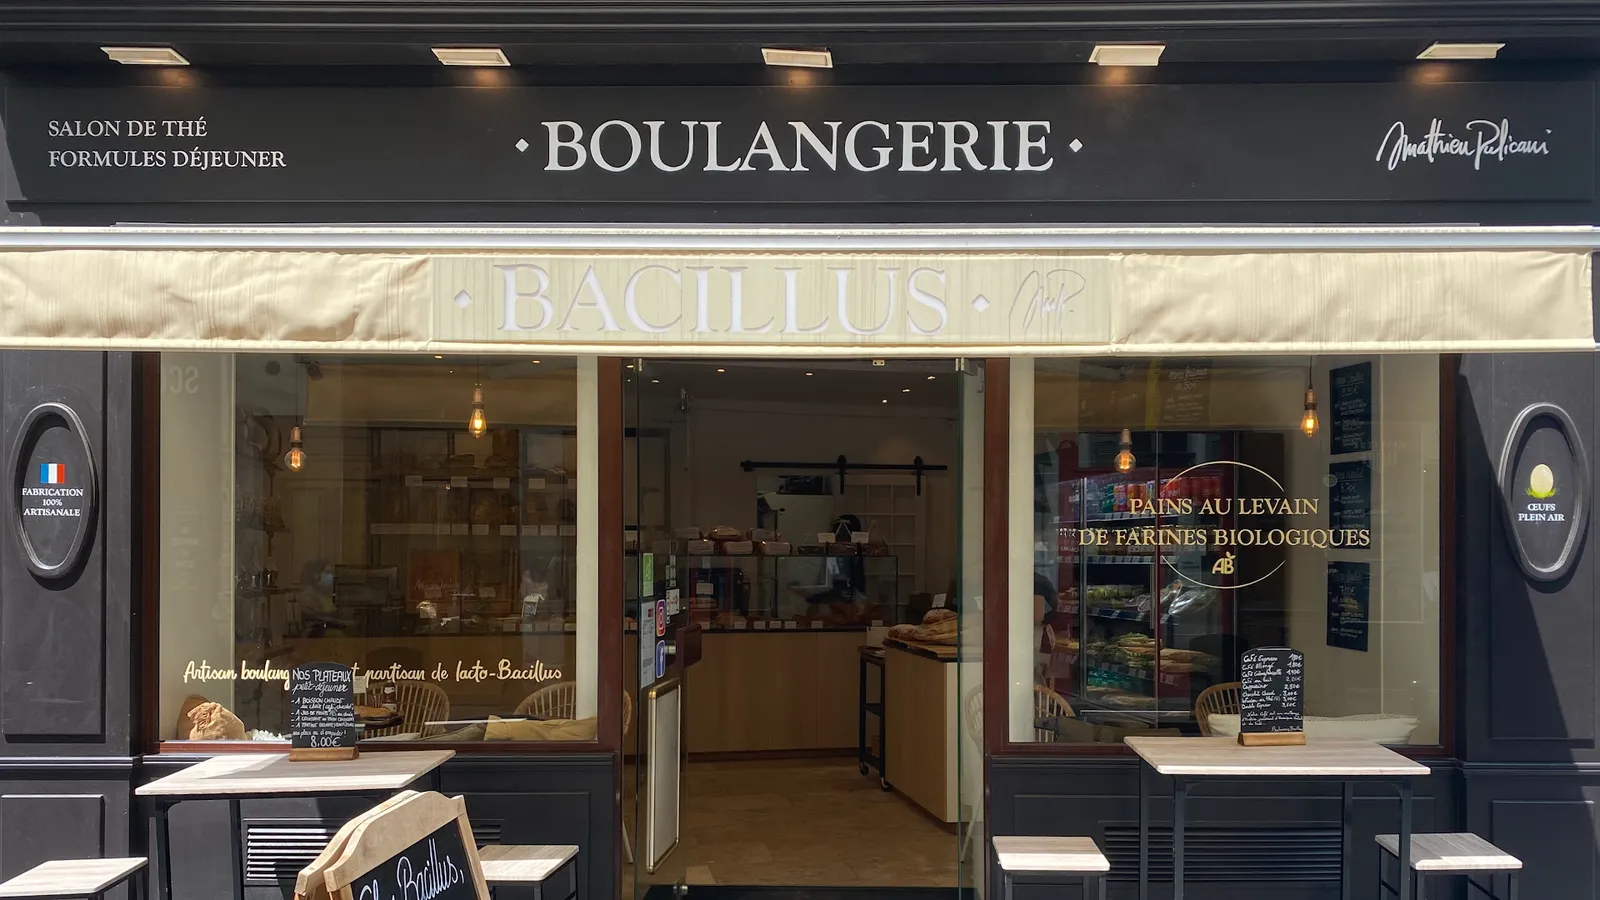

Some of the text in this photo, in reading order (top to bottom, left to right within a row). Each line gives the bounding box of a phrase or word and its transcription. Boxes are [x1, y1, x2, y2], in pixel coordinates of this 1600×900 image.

[48, 116, 207, 137] SALON DE THÉ
[541, 120, 1054, 173] BOULANGERIE
[48, 146, 287, 171] FORMULES DÉJEUNER
[493, 264, 948, 335] BACILLUS
[21, 487, 84, 497] FABRICATION
[42, 498, 63, 506] 100%
[1130, 498, 1193, 516] PAINS
[1200, 498, 1231, 516] AU
[1237, 498, 1320, 516] LEVAIN
[1527, 503, 1556, 512] ŒUFS
[23, 507, 81, 517] ARTISANALE
[1518, 513, 1565, 522] PLEIN AIR
[1078, 528, 1371, 549] DE FARINES BIOLOGIQUES
[183, 660, 237, 683] Artisan
[241, 660, 290, 690] boulang
[365, 663, 426, 688] partisan
[431, 662, 449, 680] de
[455, 658, 562, 683] lacto-Bacillus
[292, 667, 352, 683] NOS PLATEAUX
[292, 681, 349, 697] petit-déjeuner
